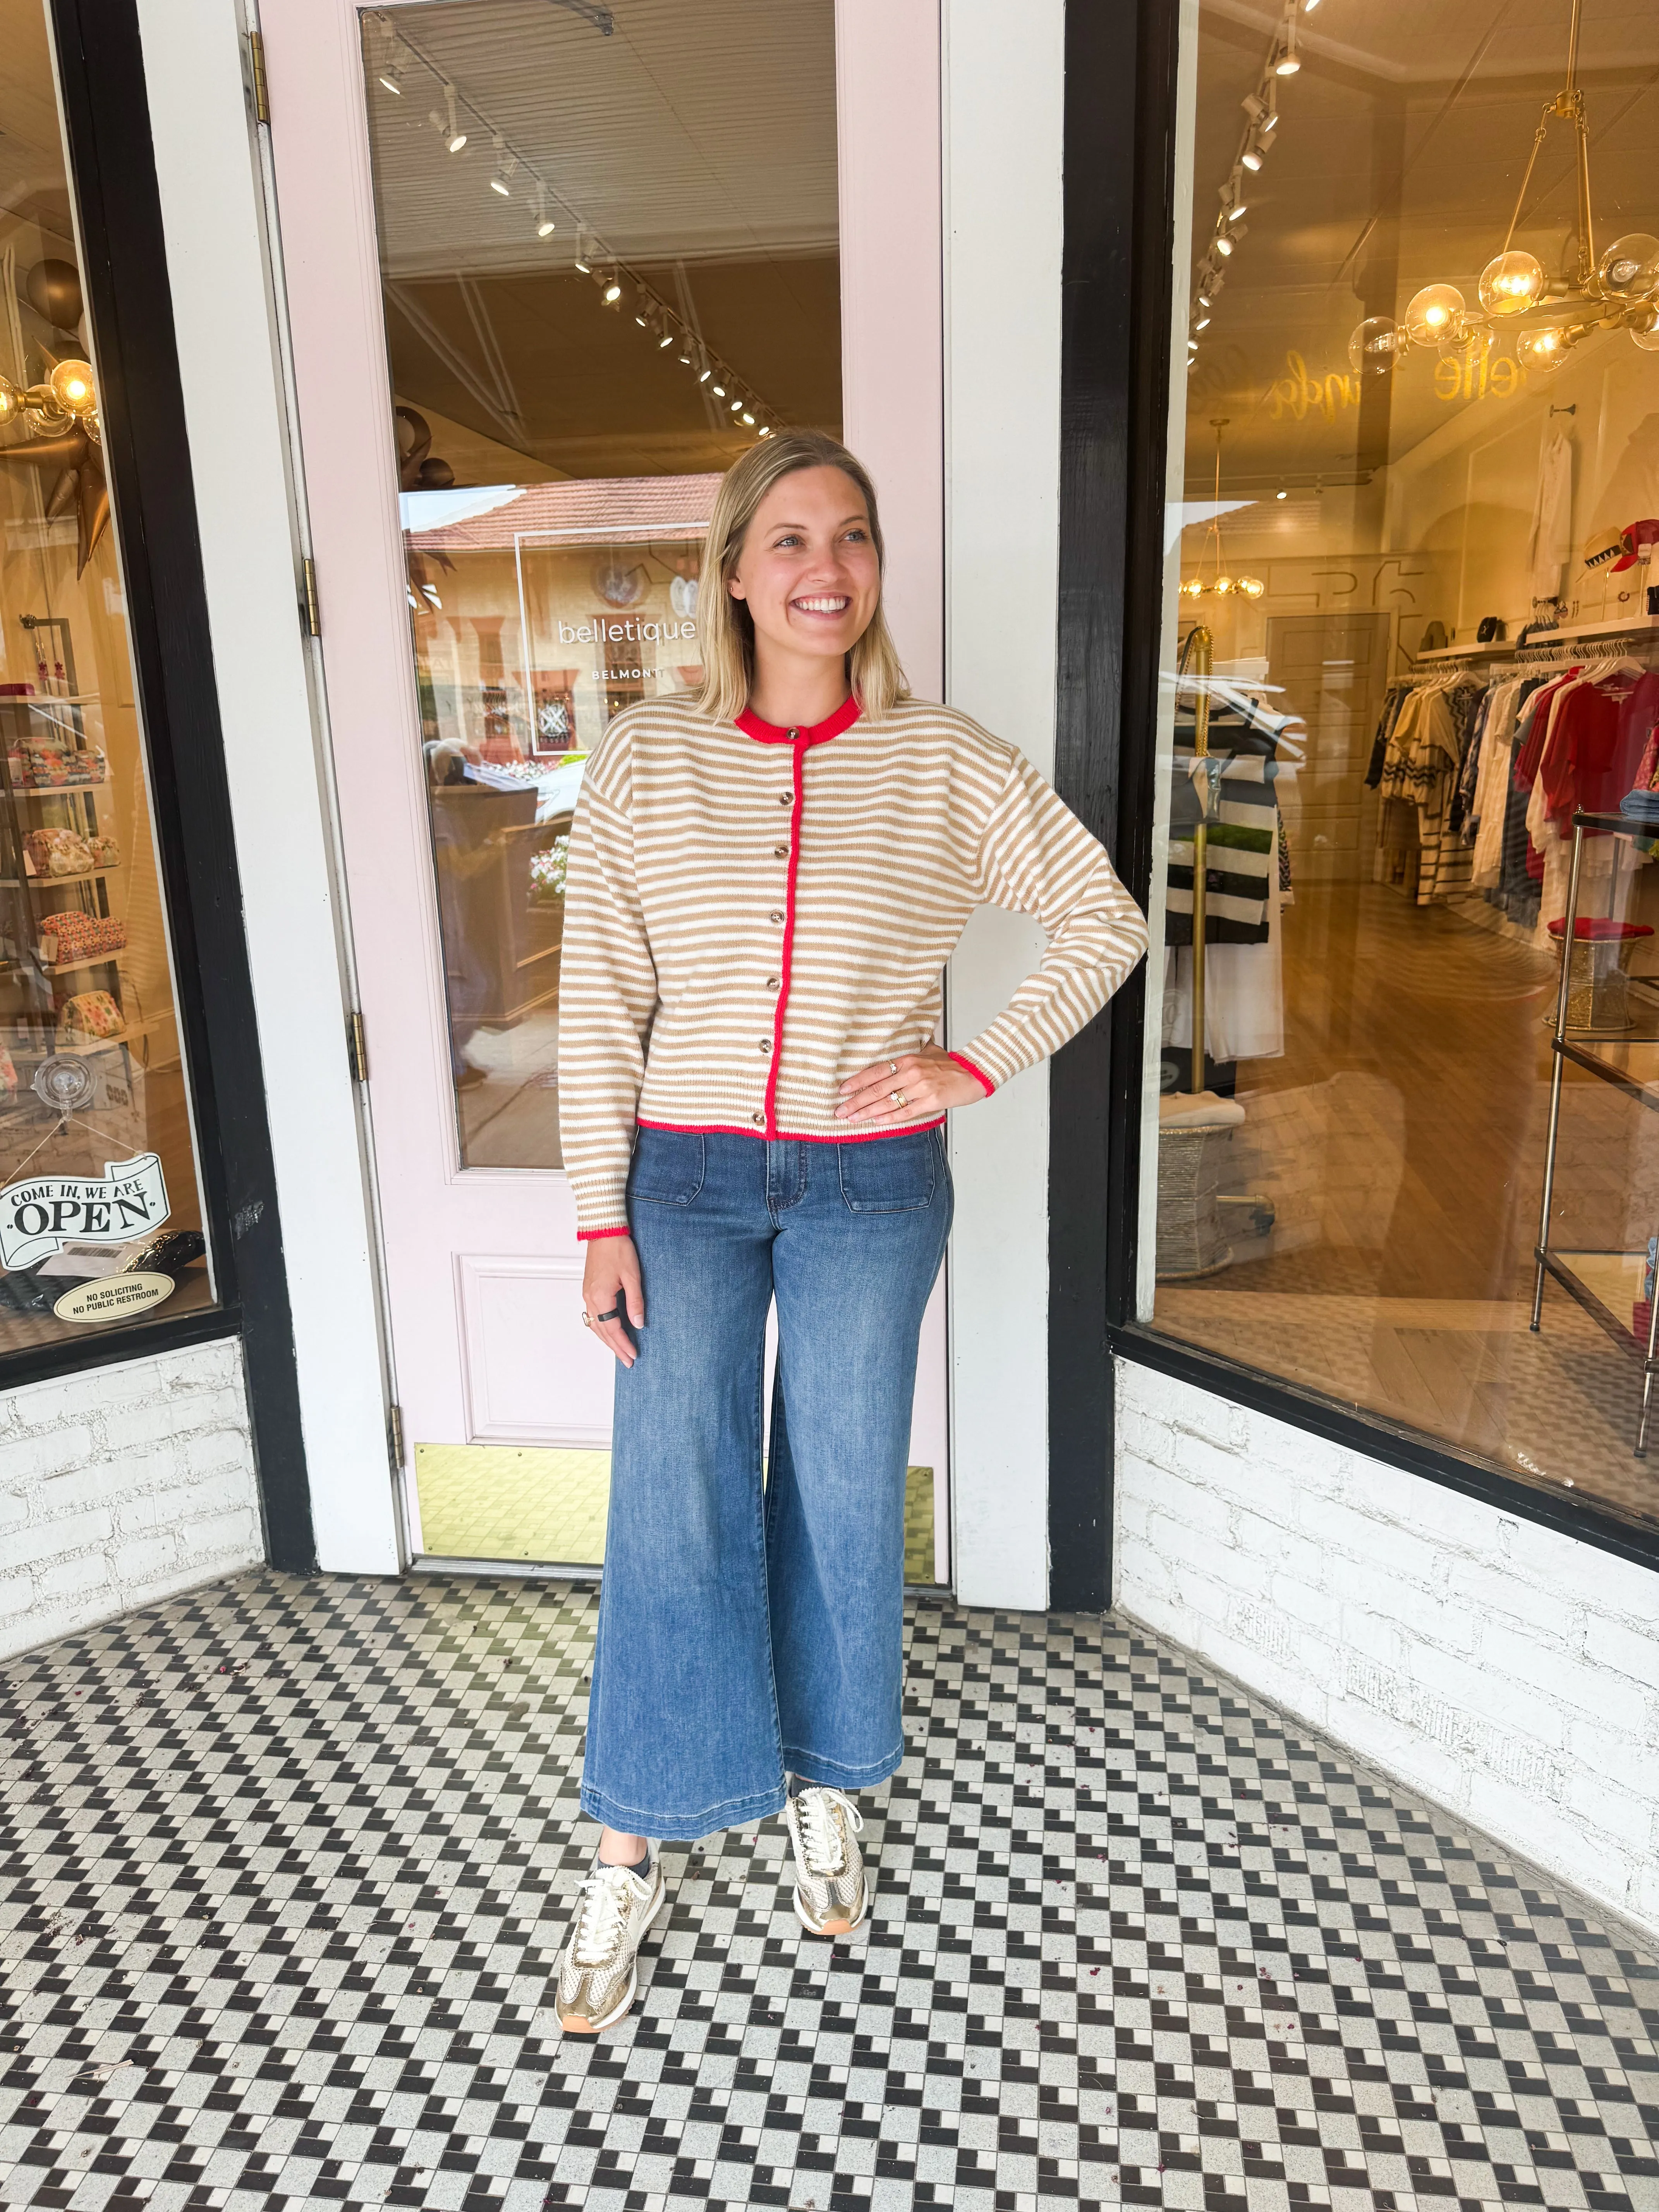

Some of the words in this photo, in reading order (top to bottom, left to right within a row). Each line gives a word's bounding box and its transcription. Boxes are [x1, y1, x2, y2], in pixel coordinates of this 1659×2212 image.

[558, 617, 696, 646] belletique
[592, 669, 659, 680] BELMONT
[11, 1185, 53, 1206] COME
[60, 1185, 80, 1199] IN,
[85, 1187, 106, 1199] WE
[114, 1179, 143, 1197] ARE
[14, 1191, 151, 1235] OPEN
[73, 1306, 84, 1314] NO
[87, 1299, 114, 1311] PUBLIC
[117, 1289, 159, 1304] RESTROOM
[87, 1294, 98, 1302] NO
[100, 1283, 143, 1299] SOLICITING
